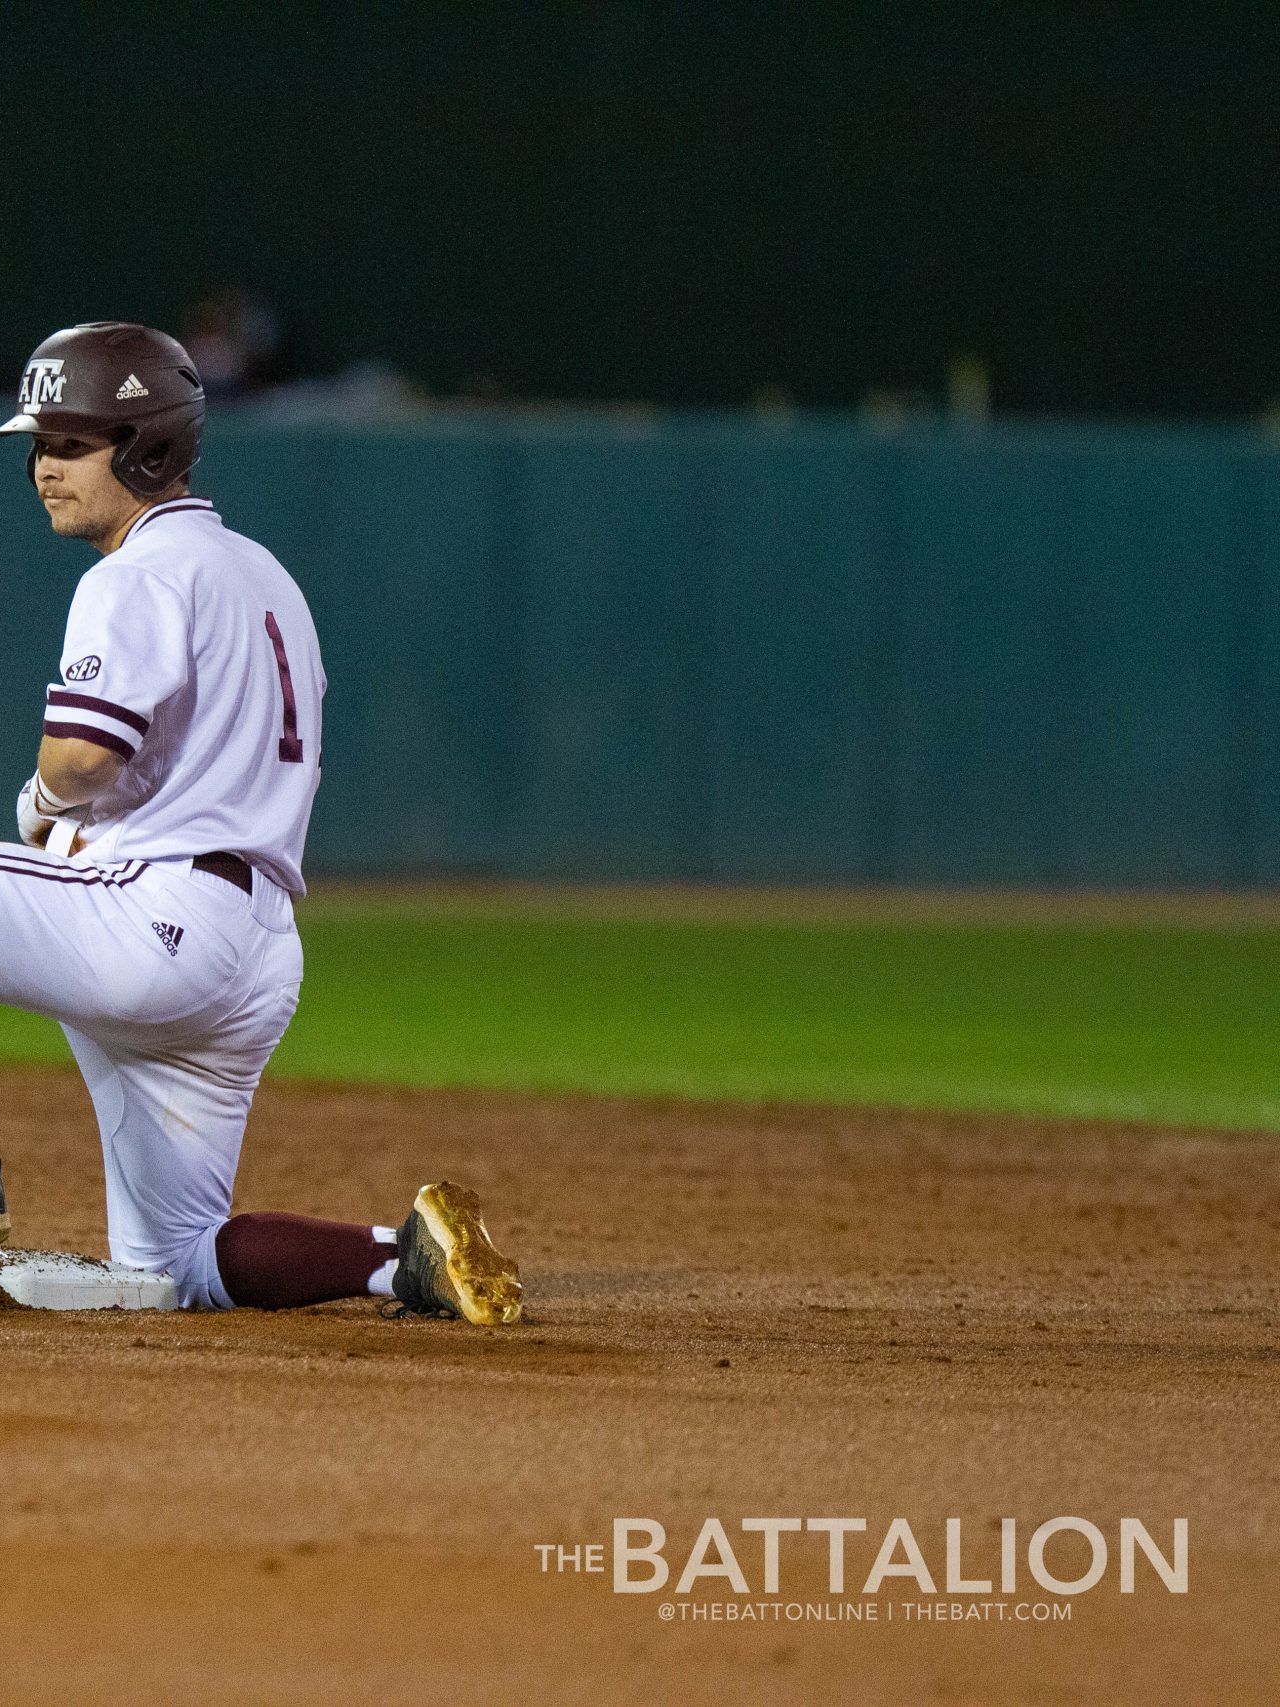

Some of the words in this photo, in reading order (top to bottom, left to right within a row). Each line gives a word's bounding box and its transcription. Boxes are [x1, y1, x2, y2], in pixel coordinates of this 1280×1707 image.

[116, 387, 149, 400] adidas
[67, 656, 101, 680] SEC
[151, 921, 178, 957] adidas
